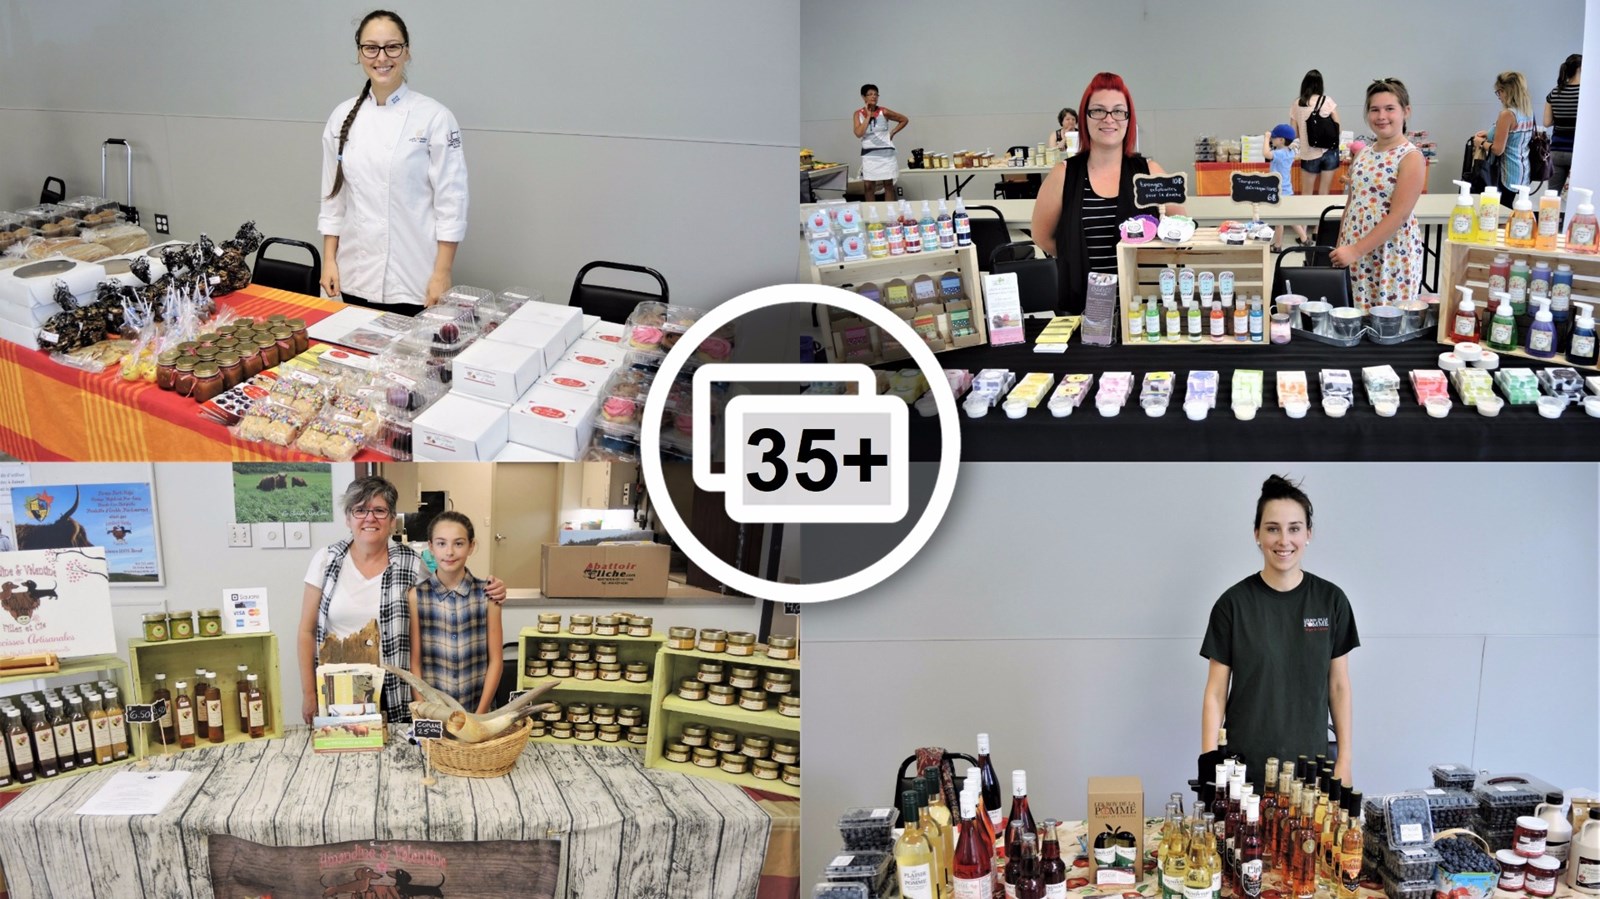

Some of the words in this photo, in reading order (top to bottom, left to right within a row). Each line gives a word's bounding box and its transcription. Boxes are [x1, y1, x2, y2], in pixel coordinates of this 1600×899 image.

[586, 562, 636, 570] Abattoir
[0, 639, 24, 647] cisses
[27, 632, 75, 645] Artisanales
[130, 710, 151, 720] 6.50
